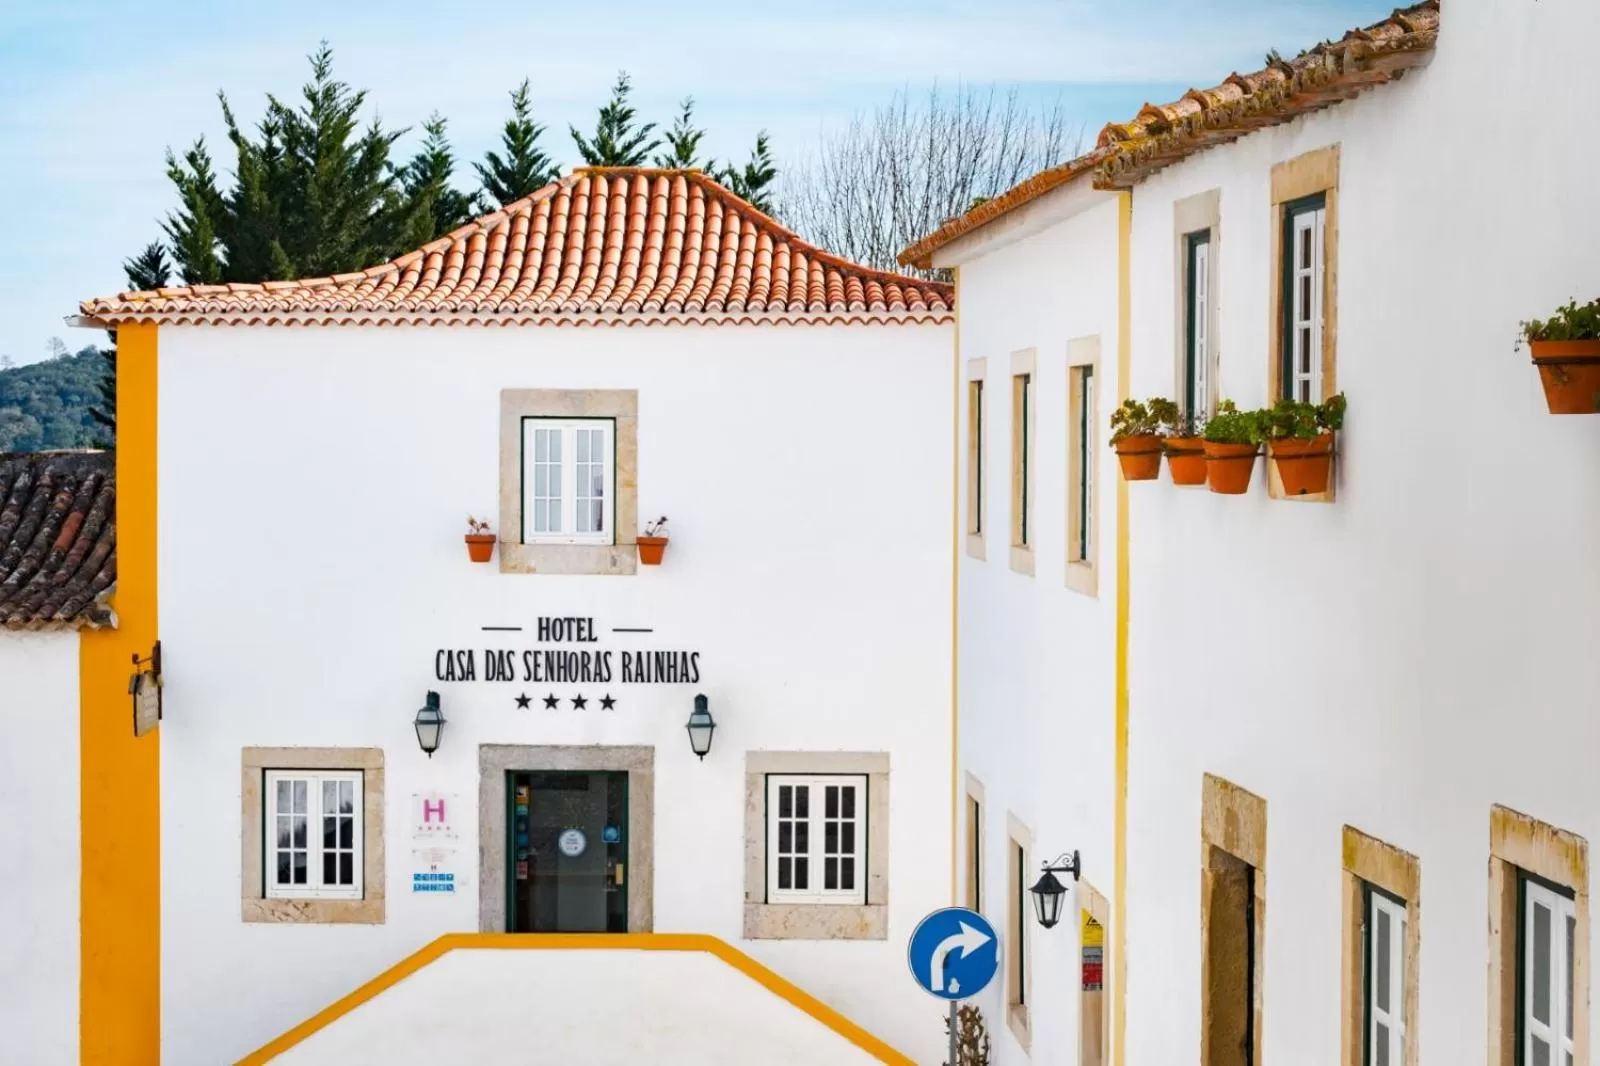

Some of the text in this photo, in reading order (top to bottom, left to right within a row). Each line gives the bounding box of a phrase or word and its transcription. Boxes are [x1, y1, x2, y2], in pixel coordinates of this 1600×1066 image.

[537, 616, 598, 642] HOTEL
[435, 649, 700, 684] CASA DAS SENHORAS RAINHAS
[424, 799, 445, 823] H
